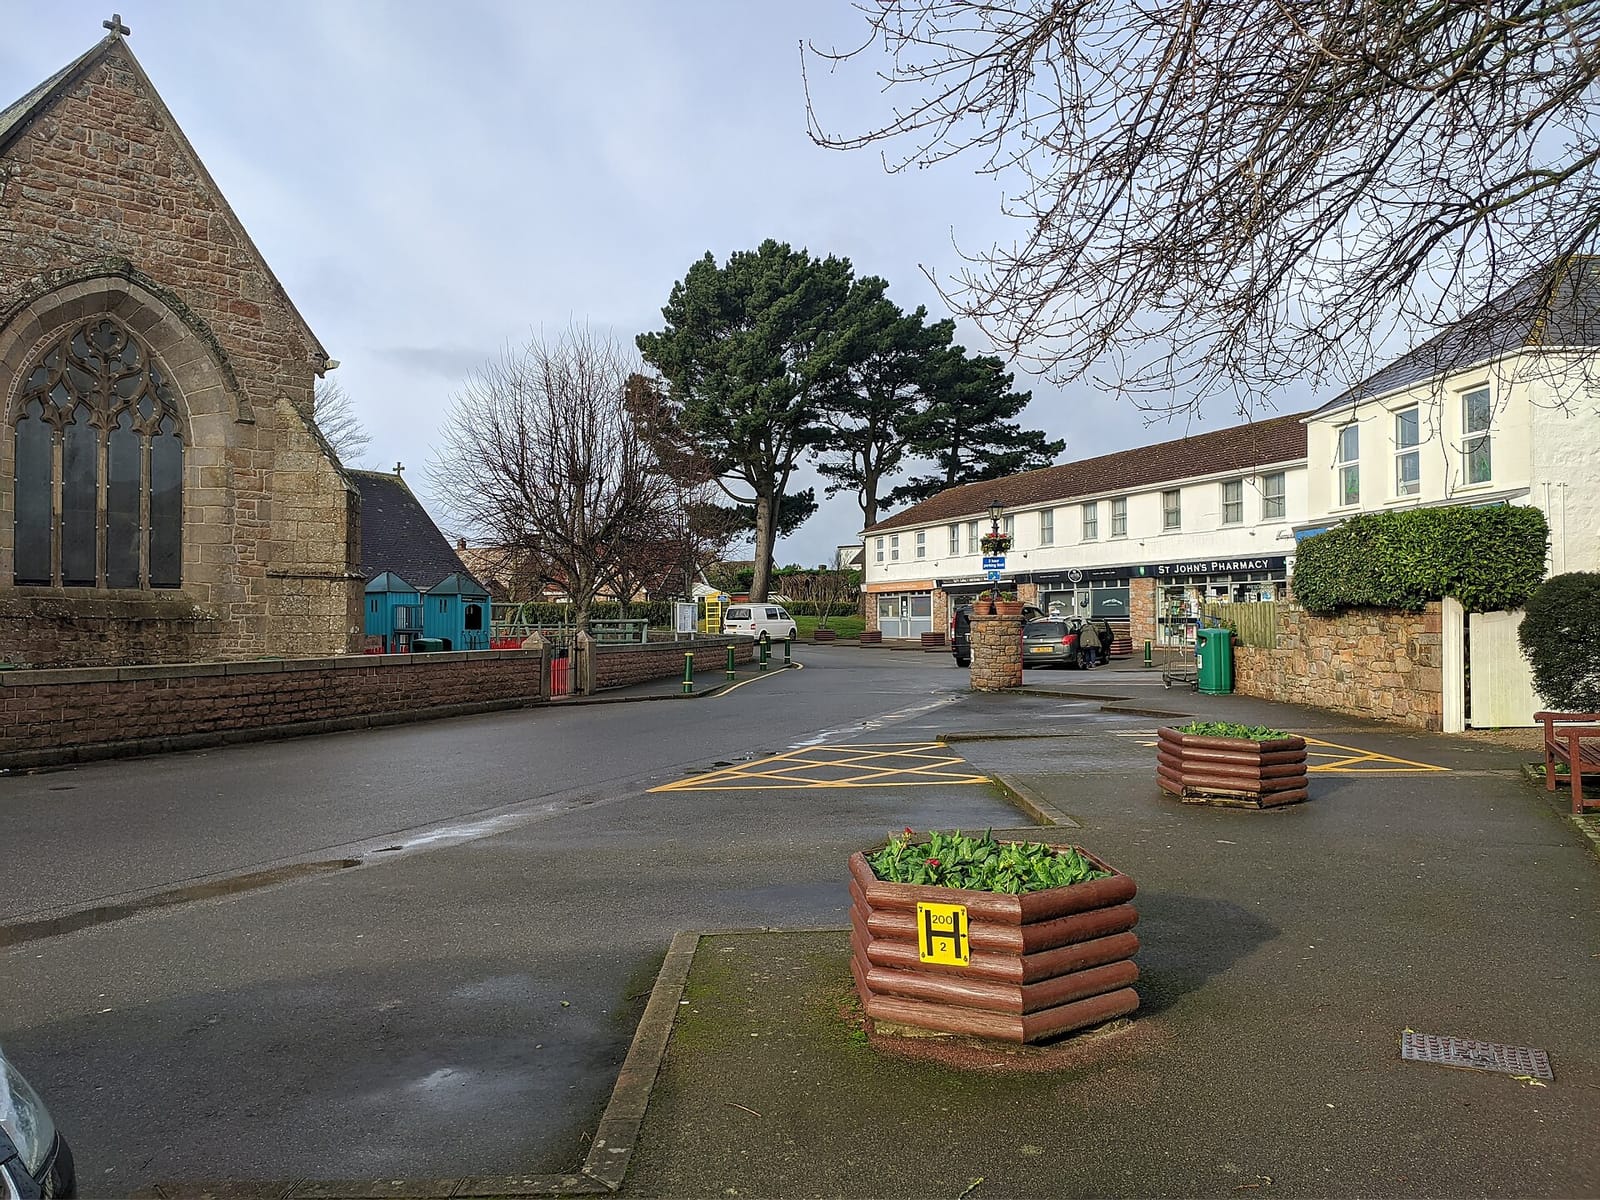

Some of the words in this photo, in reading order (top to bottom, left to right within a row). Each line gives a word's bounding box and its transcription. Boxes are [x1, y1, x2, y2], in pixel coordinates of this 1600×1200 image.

[1158, 565, 1170, 575] ST
[1174, 563, 1207, 574] JOHN'S
[1211, 559, 1269, 571] PHARMACY
[932, 914, 953, 925] 200
[940, 942, 947, 952] 2
